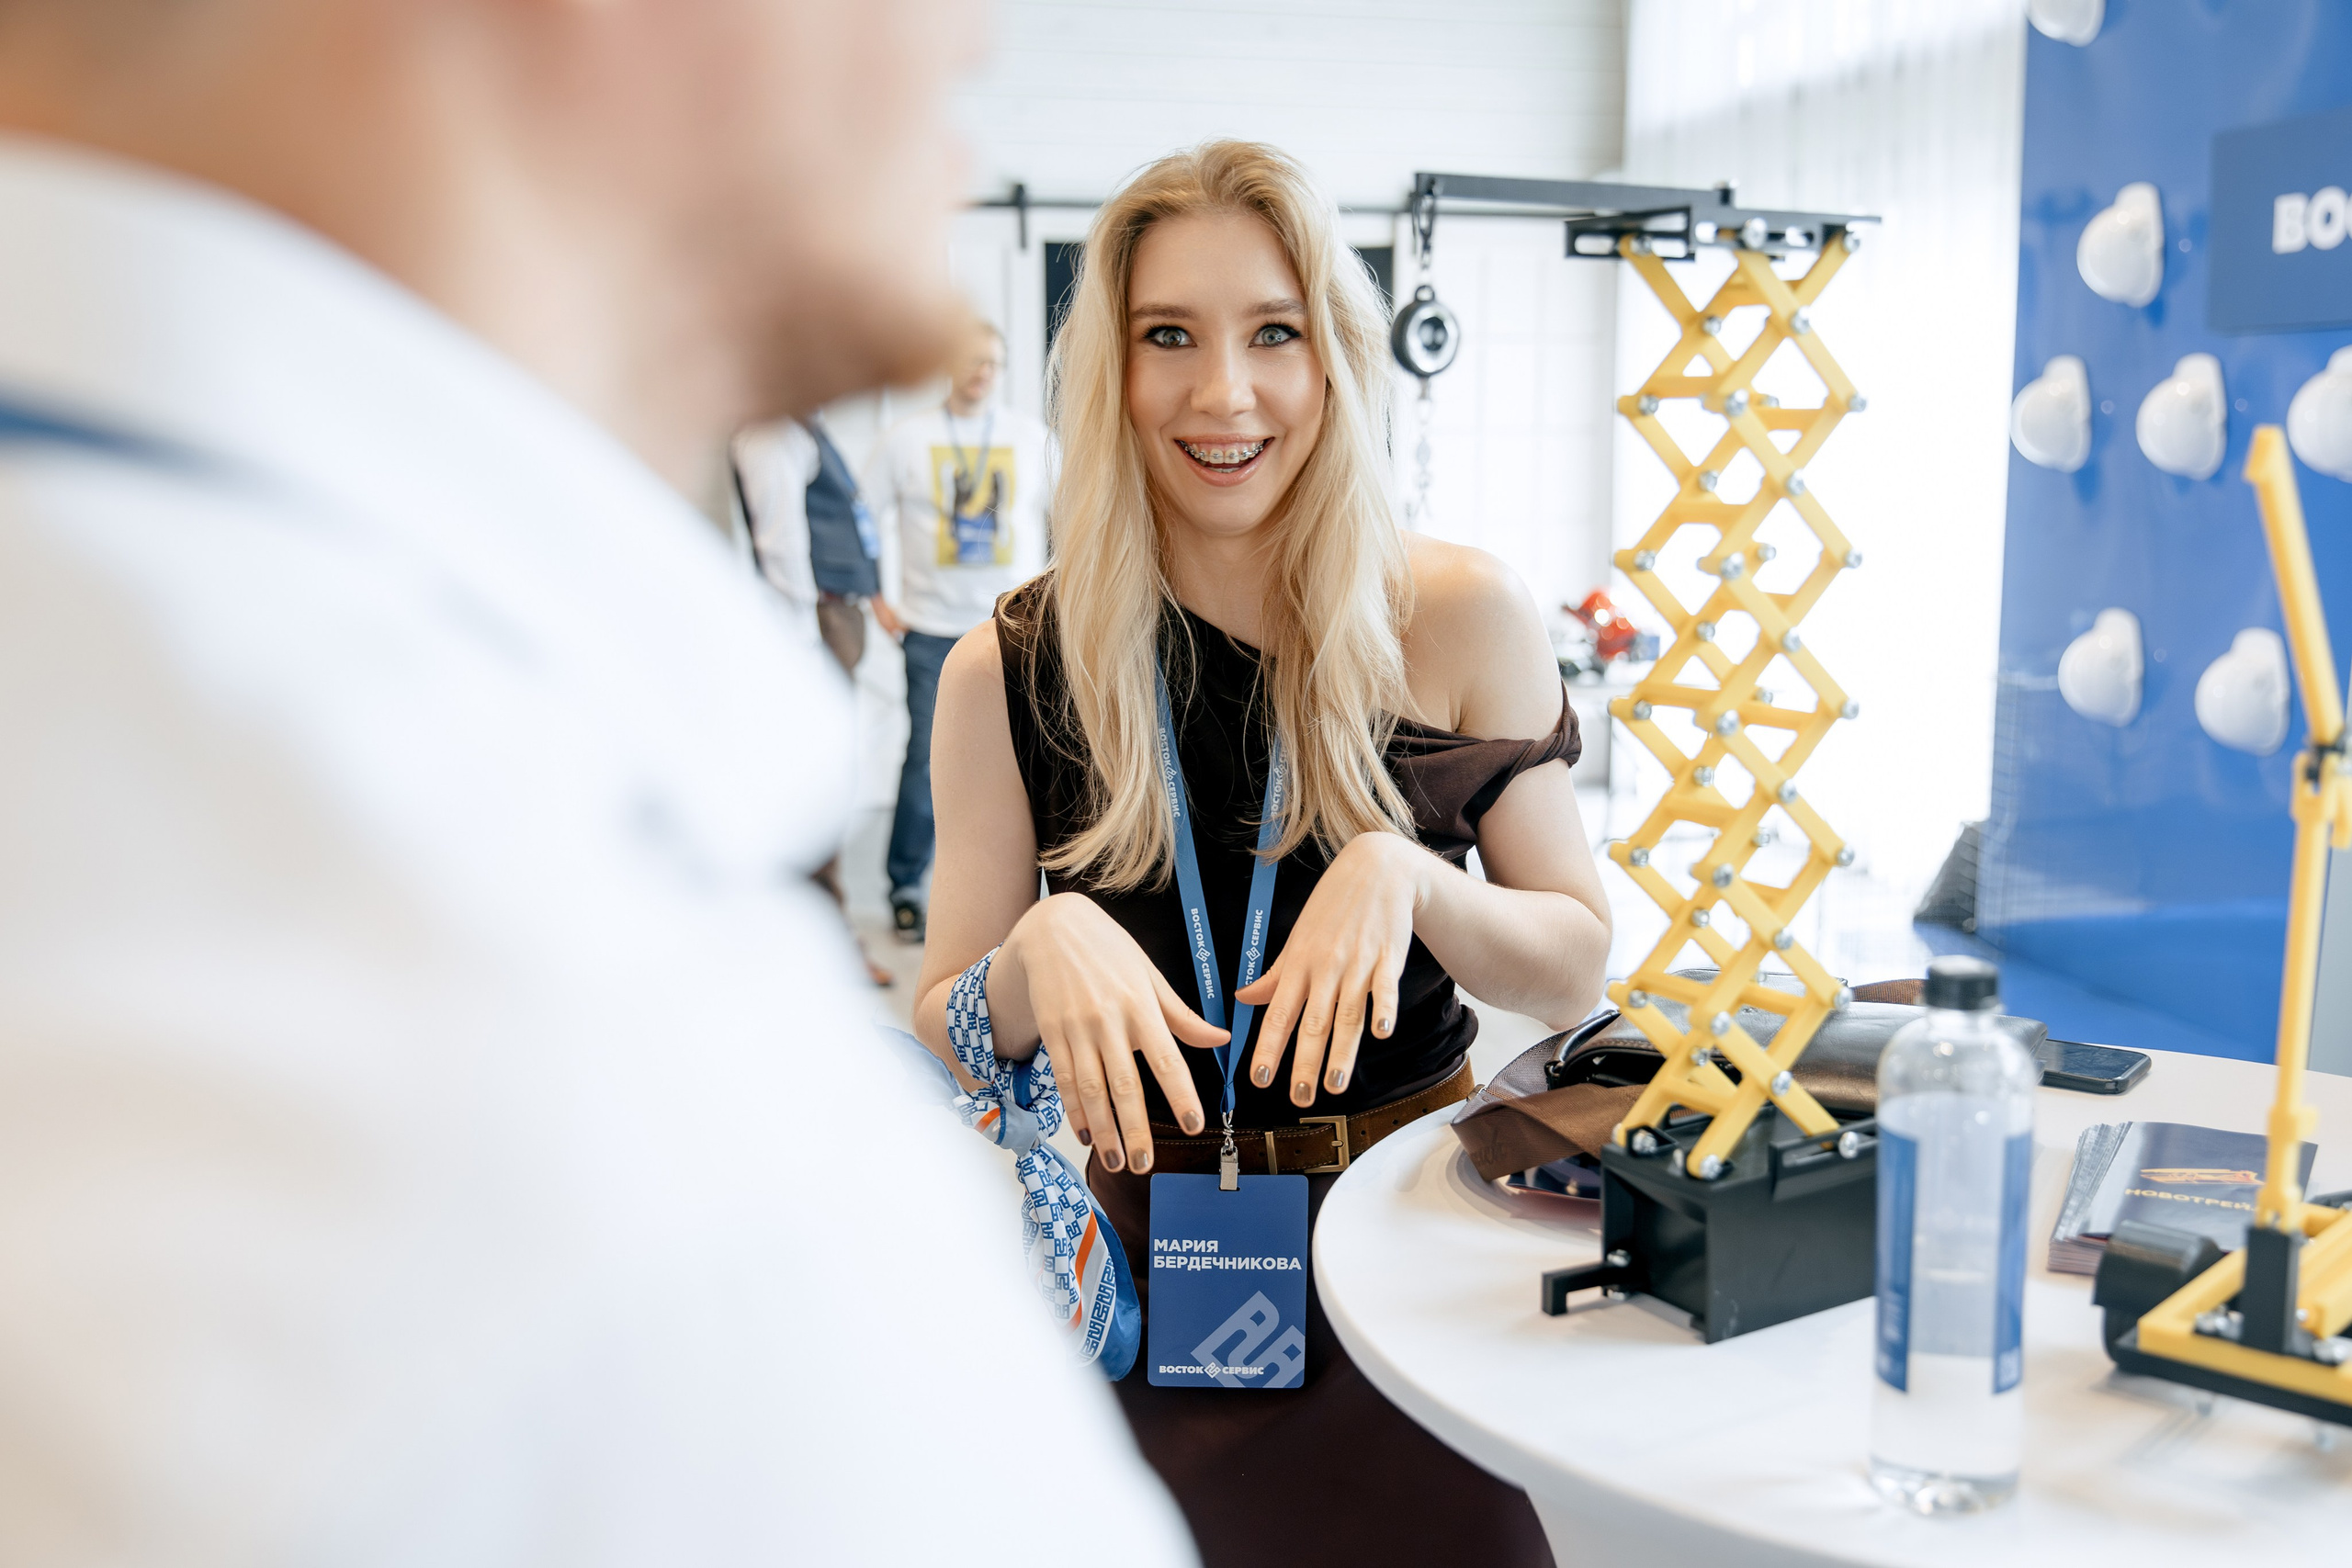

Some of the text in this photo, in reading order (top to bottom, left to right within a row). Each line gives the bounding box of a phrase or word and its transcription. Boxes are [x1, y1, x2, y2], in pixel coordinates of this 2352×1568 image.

[2272, 186, 2352, 254] ВО
[1159, 728, 1181, 818] ВОСТОК СЕРВИС
[1191, 908, 1215, 999] ВОСТОК СЕРВИС
[1245, 909, 1263, 986] СТОК СЕРВИС
[2124, 1189, 2257, 1211] НОВОТРЕЙ
[1153, 1238, 1219, 1253] МАРИЯ
[1153, 1255, 1303, 1271] БЕРДЕЧНИКОВА
[1159, 1365, 1264, 1375] ВОСТОК СЕРВИС
